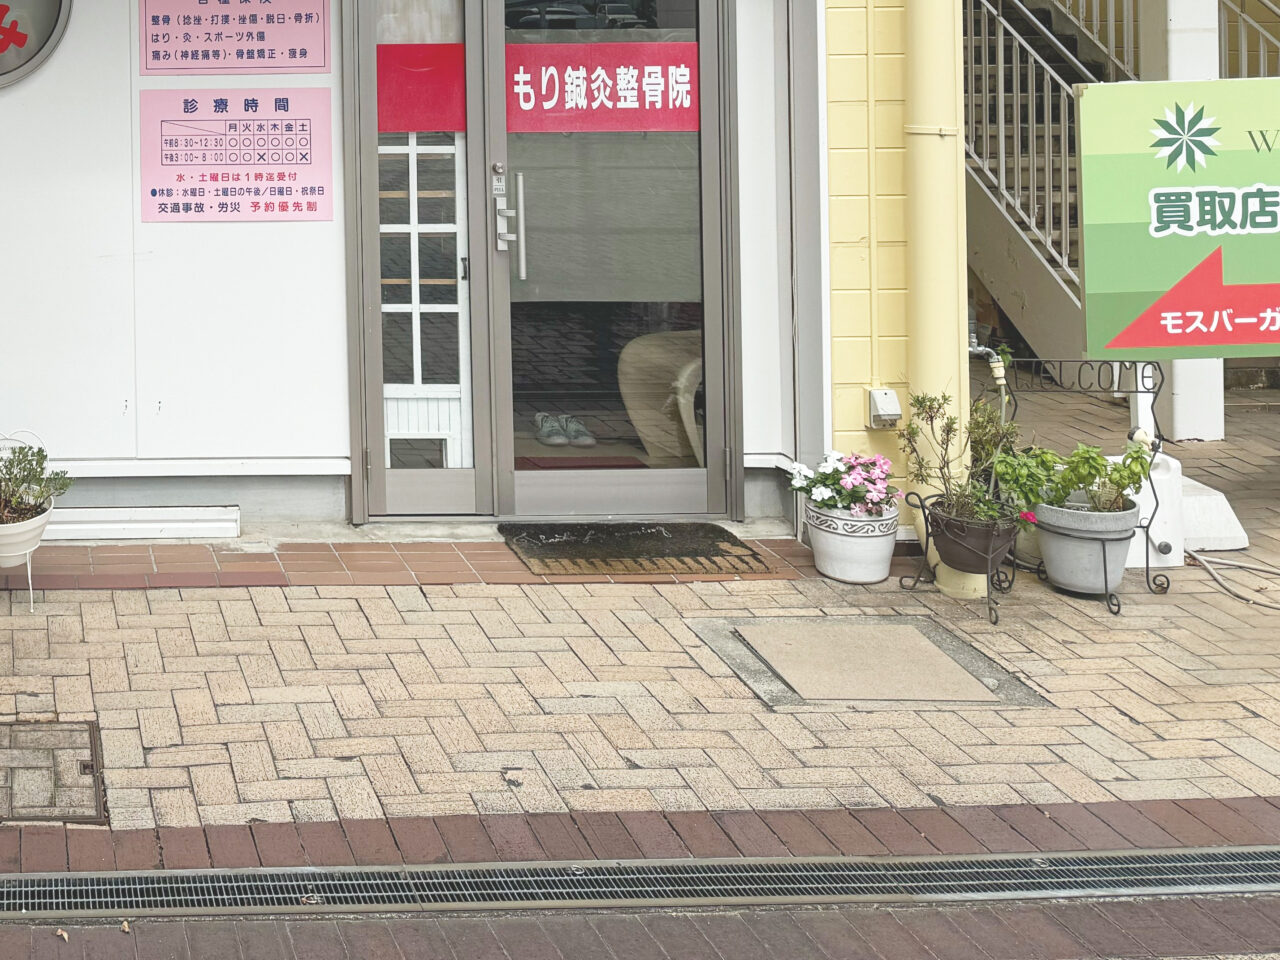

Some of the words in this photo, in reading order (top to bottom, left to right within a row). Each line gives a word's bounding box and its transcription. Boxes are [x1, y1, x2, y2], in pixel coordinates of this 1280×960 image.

[514, 64, 691, 111] もり鍼灸整骨院
[183, 98, 289, 114] 診療時間
[228, 123, 238, 133] 月
[242, 123, 252, 133] 火
[256, 123, 266, 133] 水
[270, 123, 280, 133] 木
[284, 123, 294, 133] 金
[298, 123, 308, 132] 土
[1154, 188, 1280, 233] 買取店
[1160, 307, 1280, 334] モスバーガ
